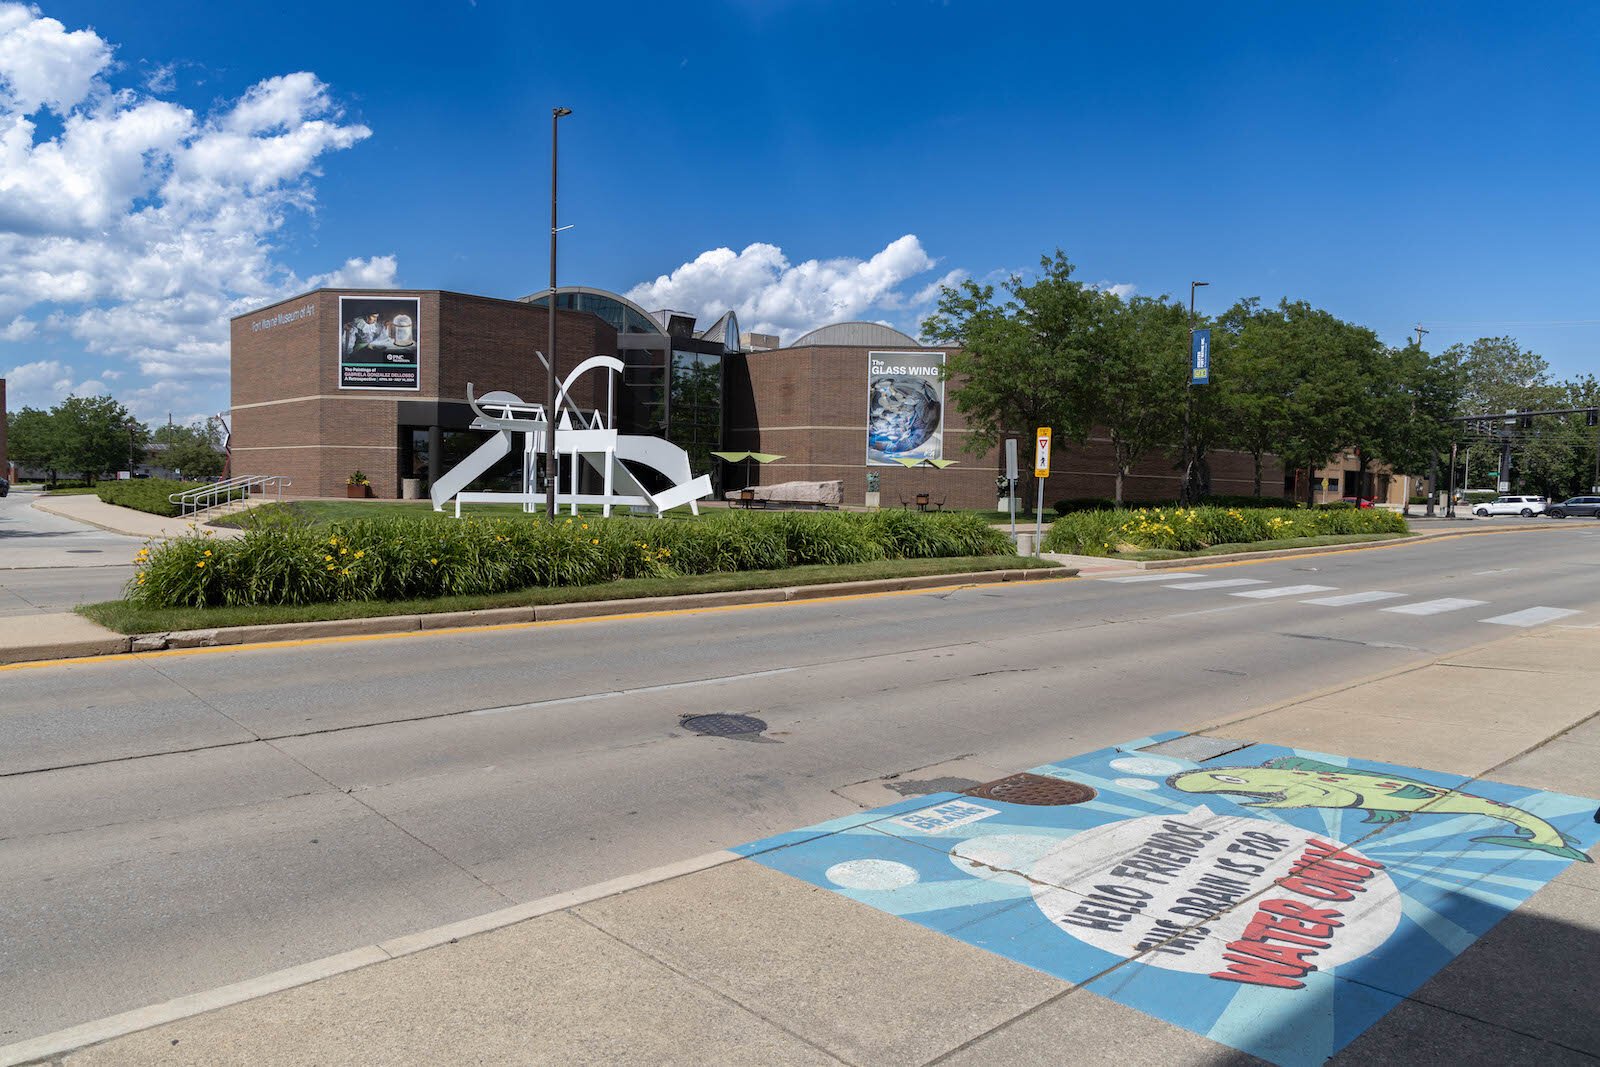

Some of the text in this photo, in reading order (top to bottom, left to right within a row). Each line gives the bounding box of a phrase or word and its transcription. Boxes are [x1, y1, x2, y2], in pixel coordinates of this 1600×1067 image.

[251, 321, 262, 332] Fort
[262, 317, 278, 330] Wayne
[278, 312, 300, 325] Museum
[307, 304, 316, 316] Art
[872, 366, 939, 376] GLASS WING
[902, 804, 965, 822] CLAN
[1061, 819, 1220, 932] HELLO FRIENDS!
[1134, 831, 1290, 955] THIS DRAIN IS FOR
[1208, 838, 1388, 990] WATER ONLY
